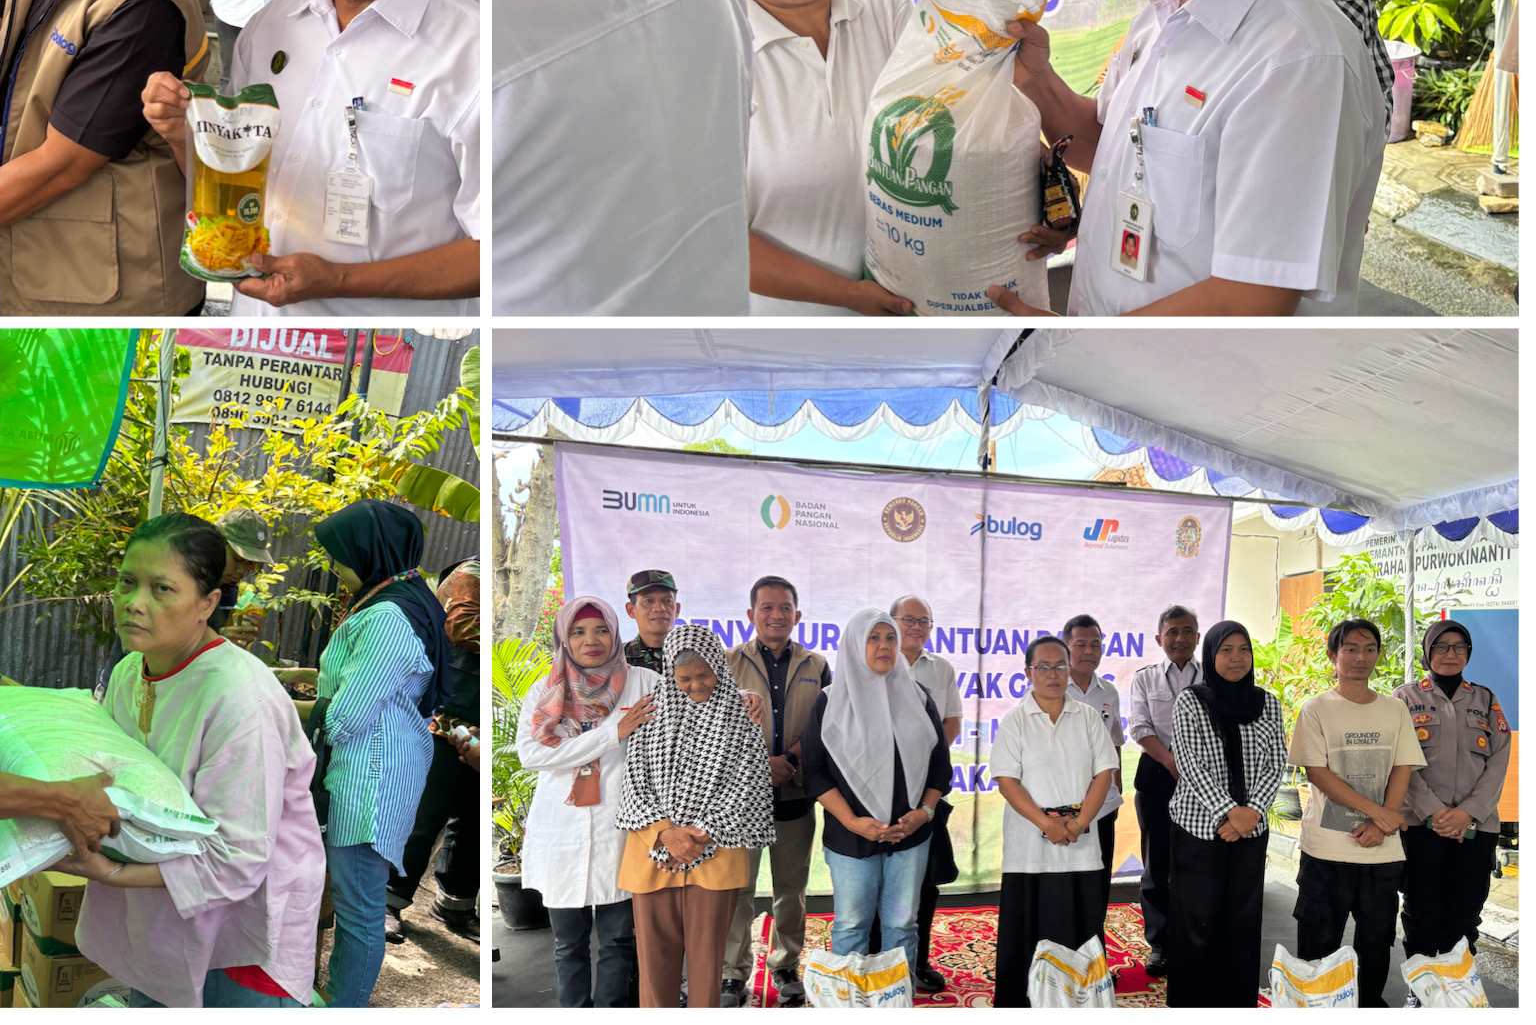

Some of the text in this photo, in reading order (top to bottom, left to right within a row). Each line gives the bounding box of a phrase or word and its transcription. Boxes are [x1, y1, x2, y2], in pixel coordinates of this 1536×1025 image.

[904, 167, 953, 196] PANGAN
[869, 191, 943, 228] BERAS MEDIUM
[885, 222, 925, 256] 10 kg
[951, 291, 981, 300] TIDAK
[230, 328, 333, 358] DIJUAL
[203, 352, 343, 380] TANPA PERANTAR
[214, 390, 250, 405] 0812
[296, 400, 333, 416] 6144
[603, 490, 670, 514] BUMN
[673, 501, 697, 510] UNTUK
[673, 508, 710, 517] INDONESIA
[795, 501, 826, 510] BADAN
[795, 510, 832, 520] PANGAN
[795, 519, 840, 530] NASIONAL
[987, 514, 1042, 541] bulog
[1107, 534, 1129, 543] Logistics
[1415, 545, 1511, 572] PURWOKINANTI
[923, 627, 1029, 656] ANTUAN
[1345, 732, 1380, 740] GROUNDED
[884, 984, 905, 1002] bulog
